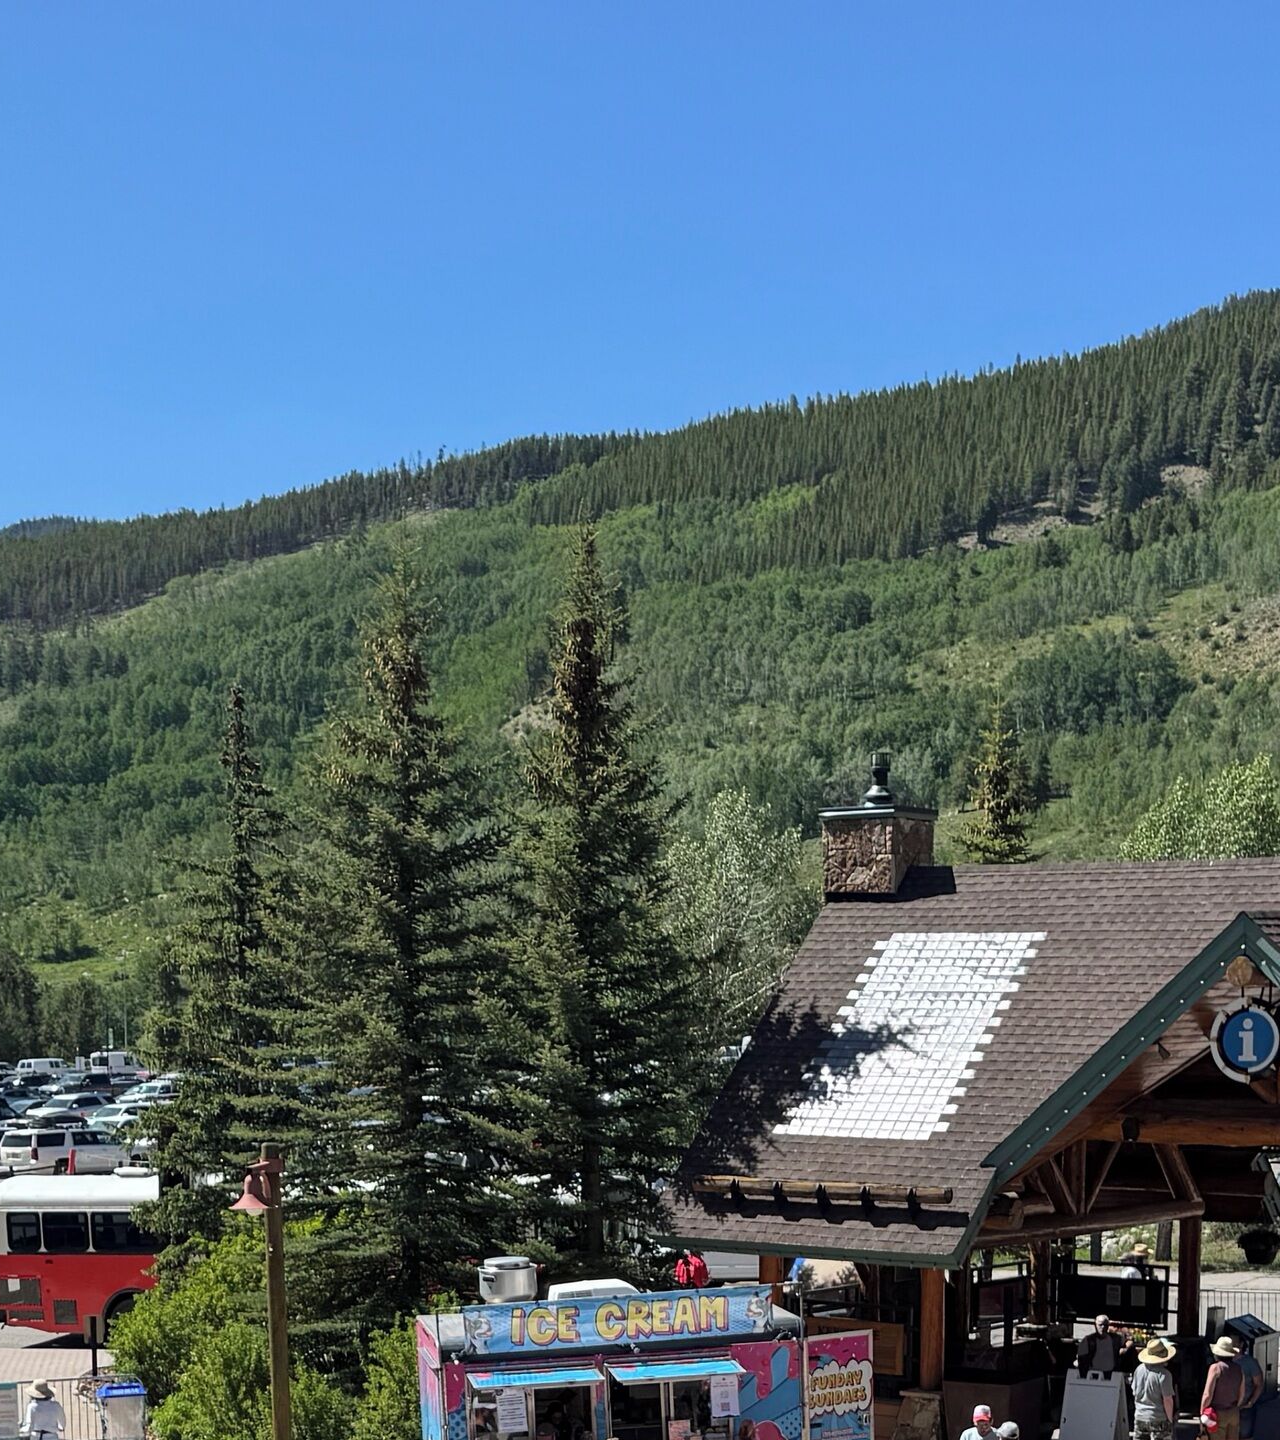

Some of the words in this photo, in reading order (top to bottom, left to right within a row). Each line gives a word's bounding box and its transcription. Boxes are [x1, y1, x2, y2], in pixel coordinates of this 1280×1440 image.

[510, 1305, 580, 1346] ICE
[595, 1296, 729, 1340] CREAM
[810, 1370, 863, 1391] FUNDAY
[808, 1386, 867, 1409] SUNDAES
